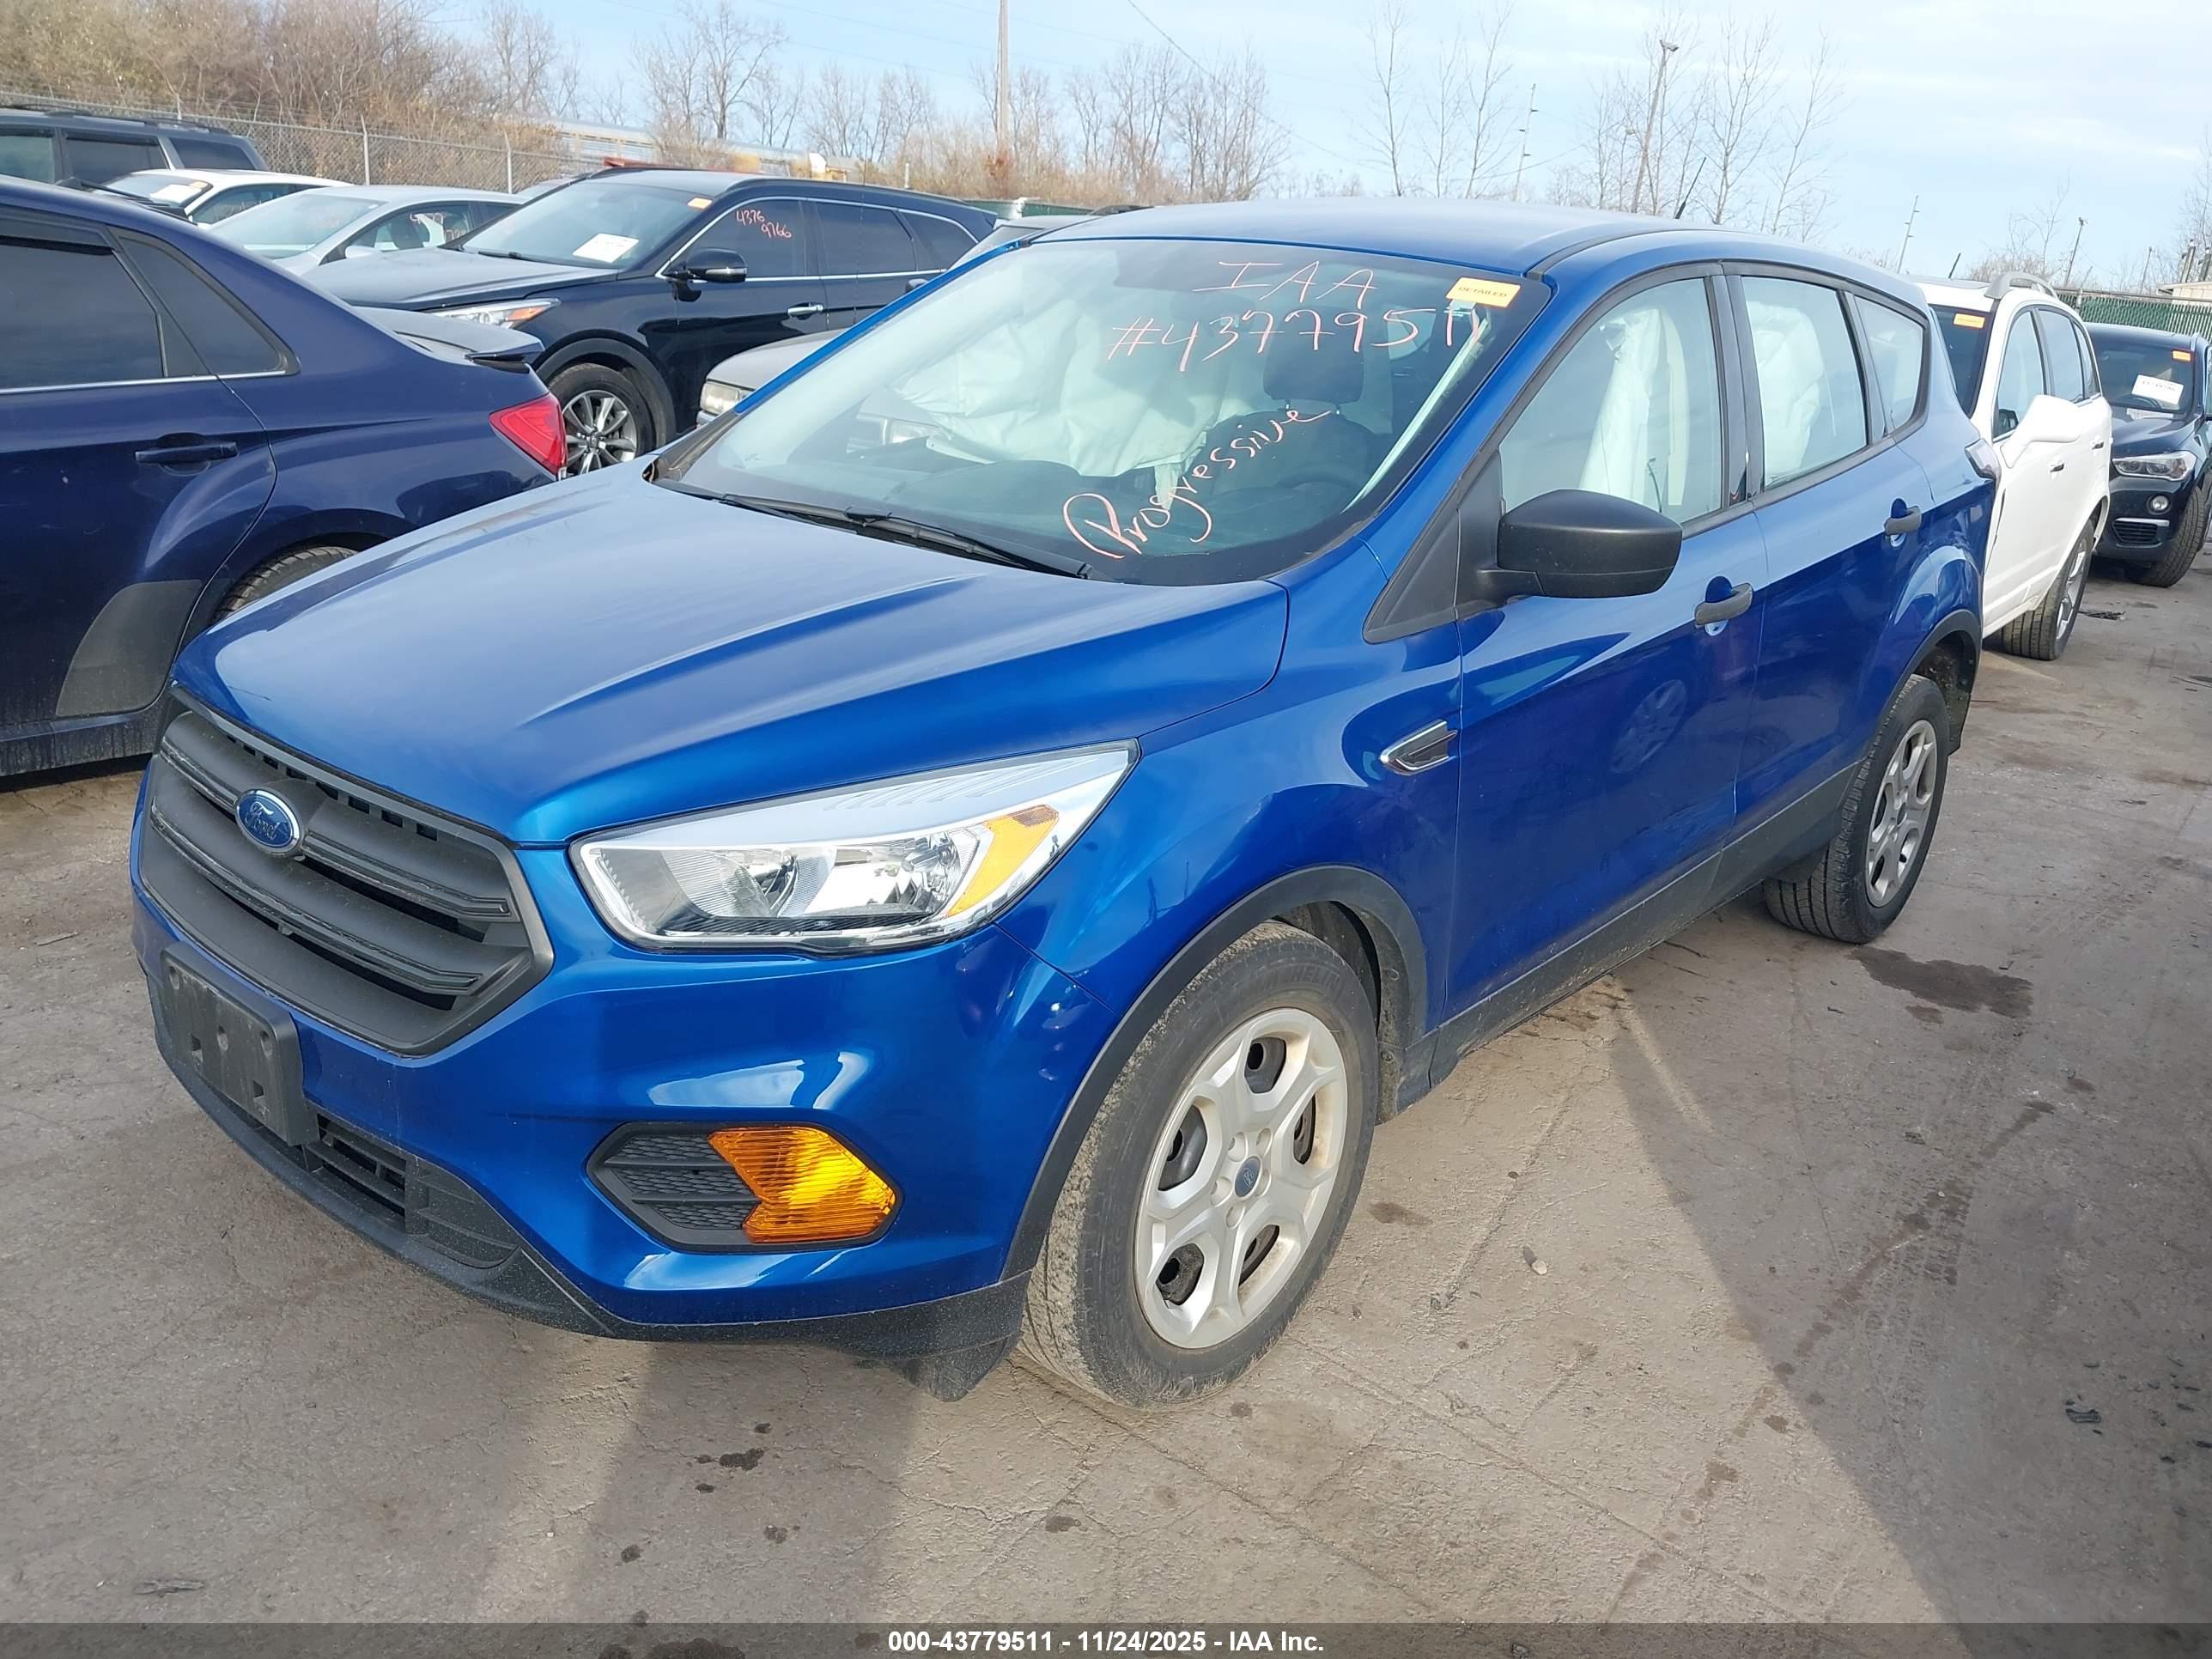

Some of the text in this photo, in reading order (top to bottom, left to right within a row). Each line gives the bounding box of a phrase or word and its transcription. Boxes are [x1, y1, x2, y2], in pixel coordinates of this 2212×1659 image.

[736, 210, 766, 226] 4376
[761, 222, 792, 238] 9766
[1192, 260, 1378, 310] IAA
[1458, 286, 1508, 298] DETAILED
[1063, 410, 1331, 558] Progressive
[245, 800, 281, 841] Ford
